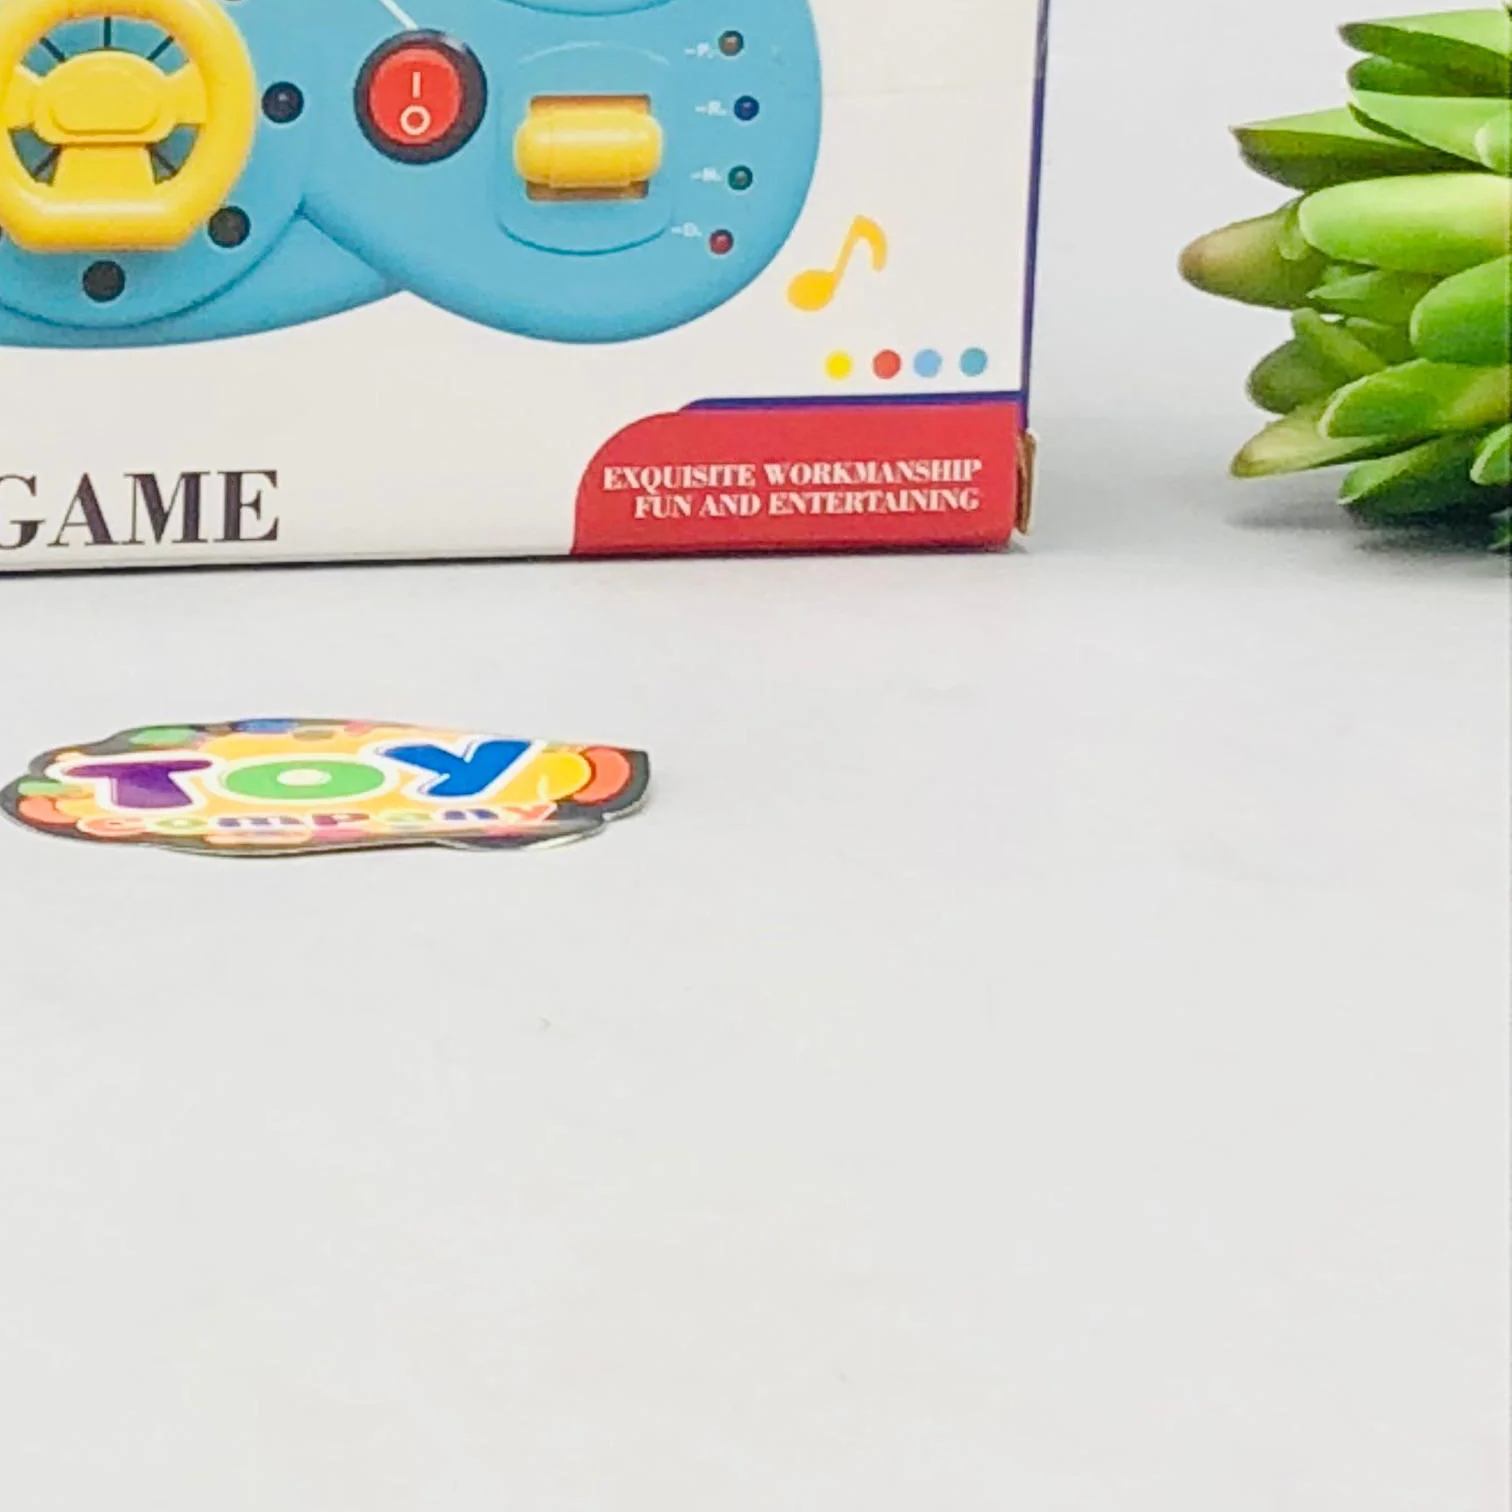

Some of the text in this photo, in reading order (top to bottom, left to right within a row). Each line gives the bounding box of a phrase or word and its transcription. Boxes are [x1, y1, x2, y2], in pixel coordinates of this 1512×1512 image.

[602, 459, 983, 493] EXQUISITE WORKMANSHIP
[634, 488, 981, 519] FUN AND ENTERTAINING
[62, 740, 533, 808] TOY
